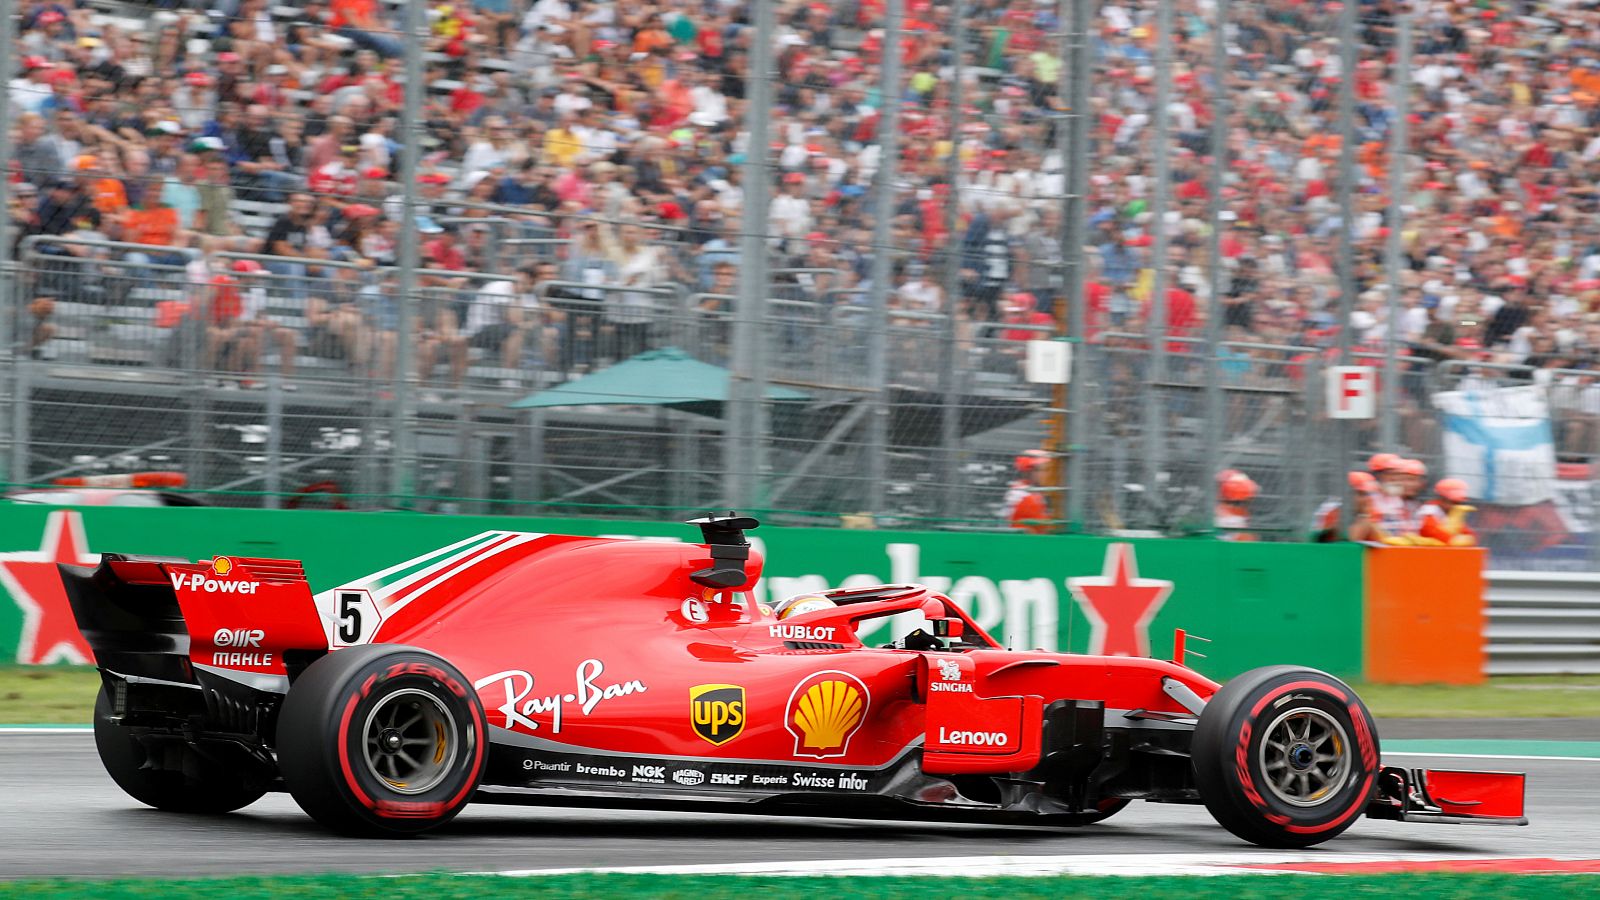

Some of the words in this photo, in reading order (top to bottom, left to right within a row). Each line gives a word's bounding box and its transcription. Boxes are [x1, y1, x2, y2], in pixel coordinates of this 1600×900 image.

[1340, 373, 1368, 411] F
[170, 573, 260, 594] V-Power
[339, 593, 362, 643] 5
[769, 625, 836, 641] HUBLOT
[213, 652, 273, 666] MAHLE
[930, 682, 973, 693] SINGHA
[939, 726, 1008, 746] Lenovo
[534, 761, 572, 772] Palantir
[576, 763, 626, 778] brembo
[632, 765, 666, 779] NGK
[710, 773, 748, 785] SKF
[752, 774, 788, 785] Experis
[792, 772, 835, 788] Swisse
[838, 773, 868, 791] infor
